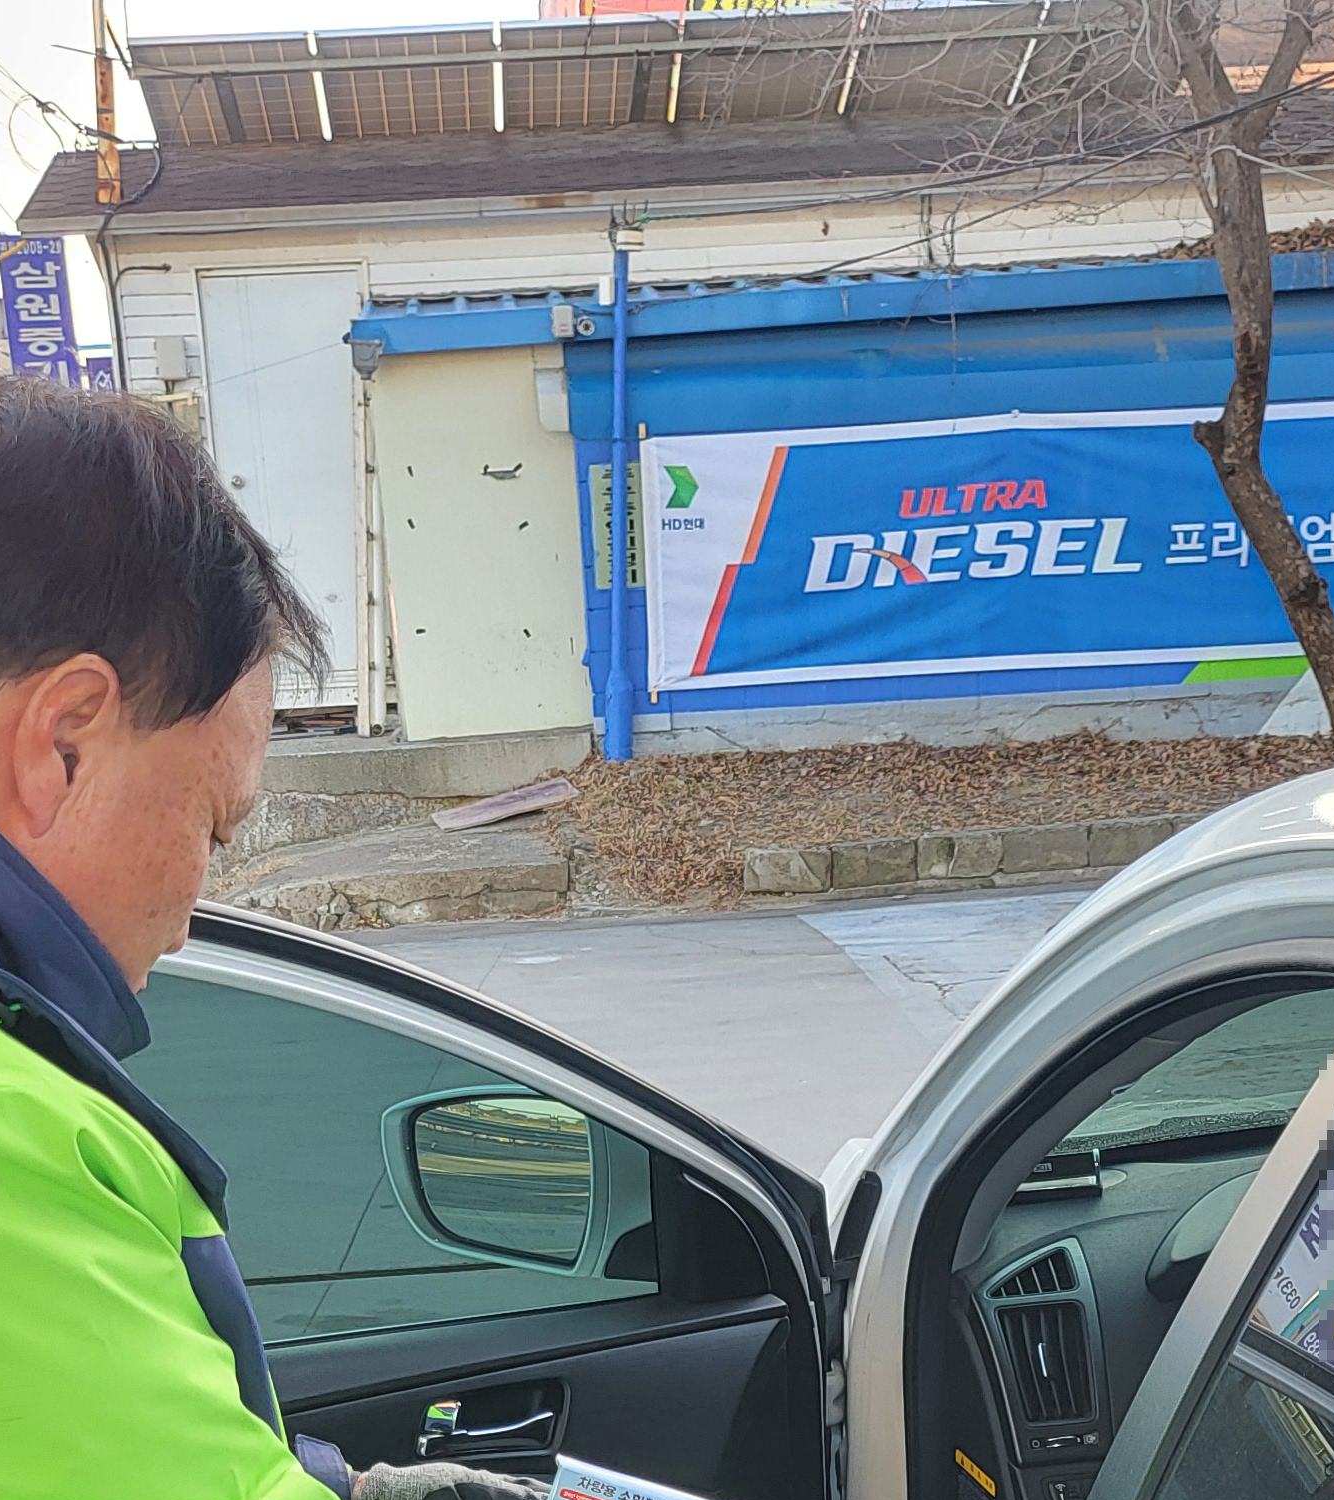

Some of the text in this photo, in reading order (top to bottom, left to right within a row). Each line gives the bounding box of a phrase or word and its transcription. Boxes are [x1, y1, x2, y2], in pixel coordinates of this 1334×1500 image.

[898, 479, 1048, 520] ULTRA
[661, 518, 705, 531] HD현대
[803, 517, 1143, 594] DIESEL
[577, 1475, 617, 1499] 차량용
